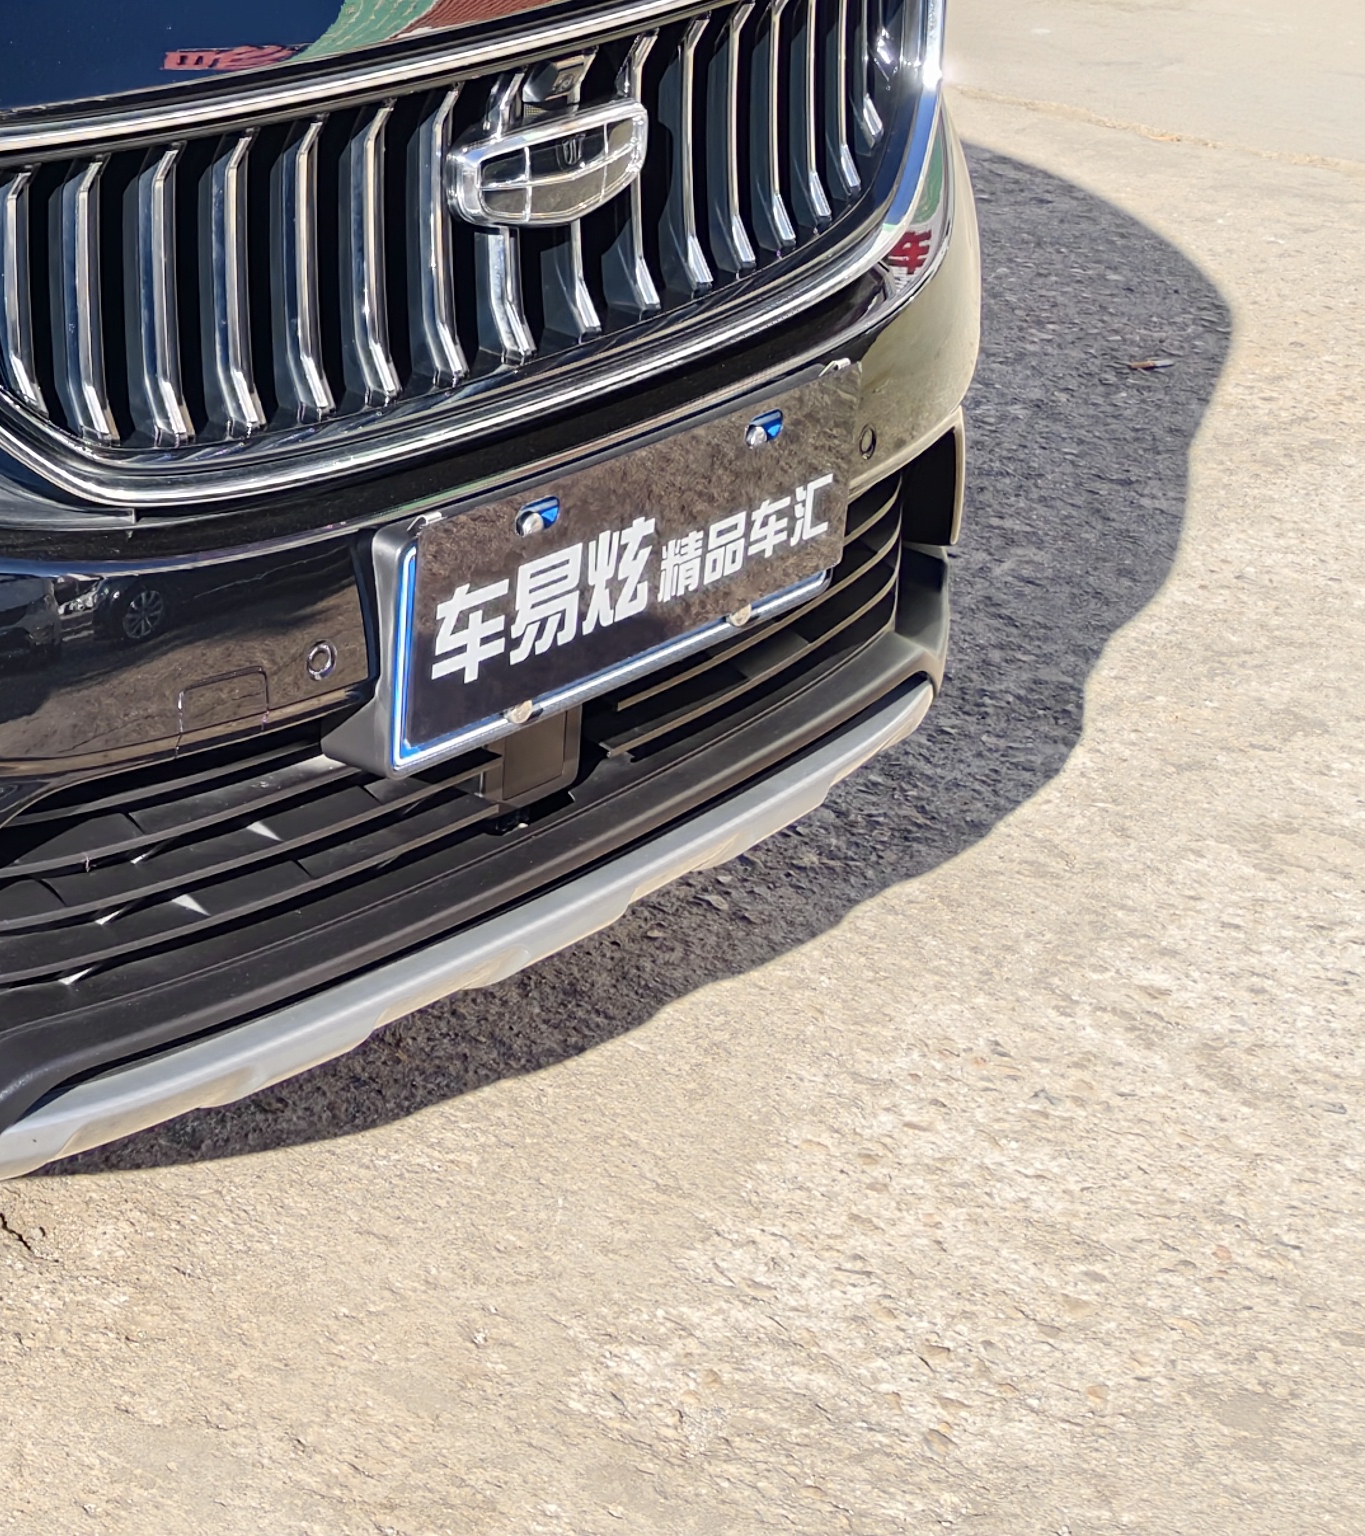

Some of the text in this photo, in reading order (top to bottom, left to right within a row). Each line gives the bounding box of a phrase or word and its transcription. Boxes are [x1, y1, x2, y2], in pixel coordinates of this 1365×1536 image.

[430, 473, 835, 685] 车易炫精品车汇
